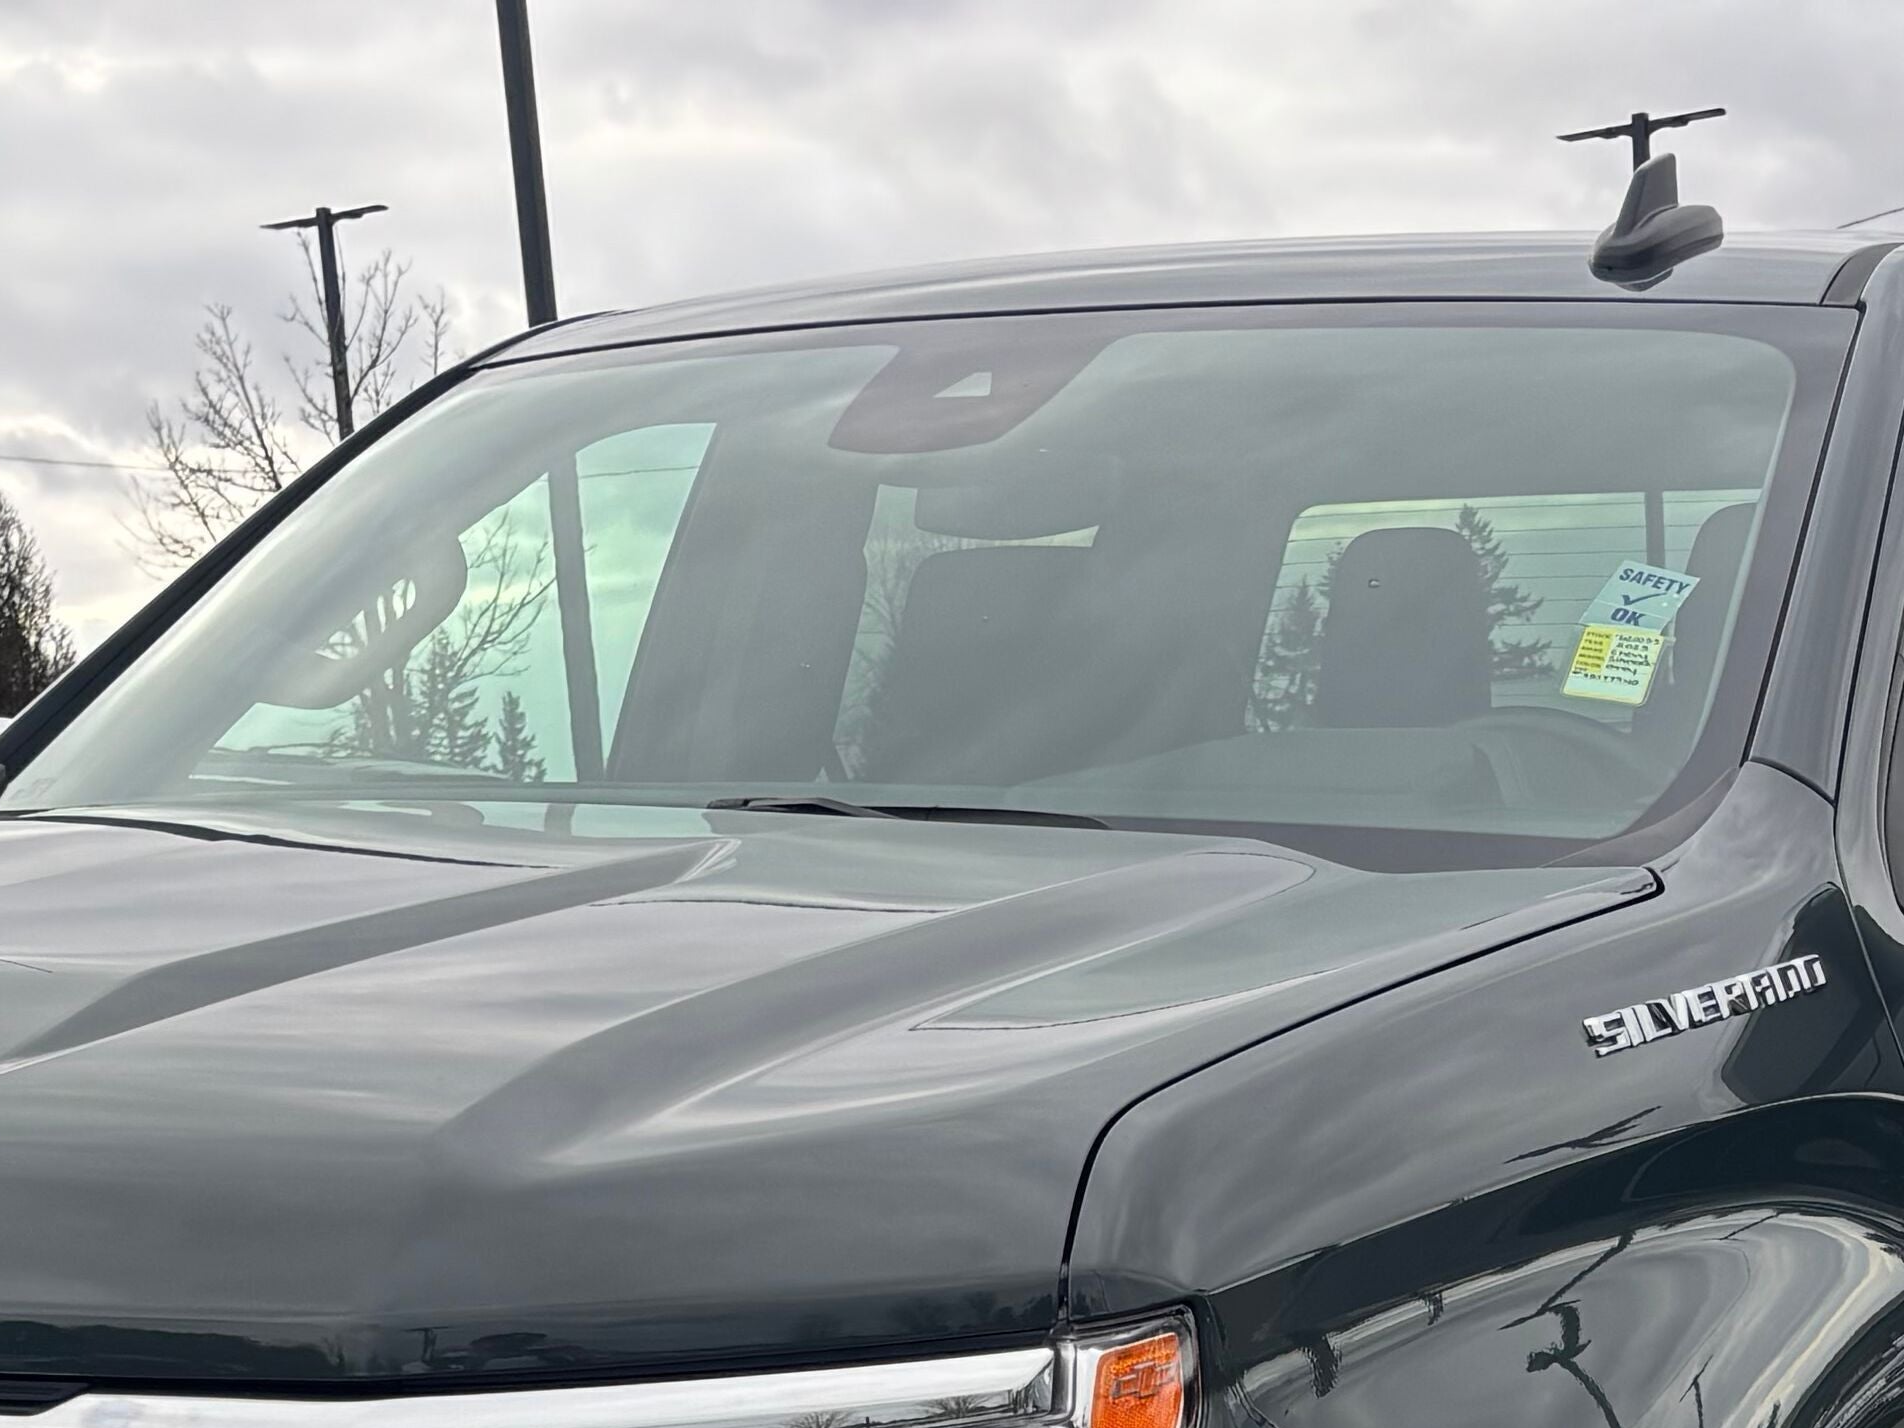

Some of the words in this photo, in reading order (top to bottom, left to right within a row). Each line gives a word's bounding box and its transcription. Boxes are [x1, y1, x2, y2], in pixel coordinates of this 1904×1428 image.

[1618, 567, 1690, 595] SAFETY
[1610, 607, 1646, 627] OK
[1582, 953, 1828, 1057] SILVERADO
